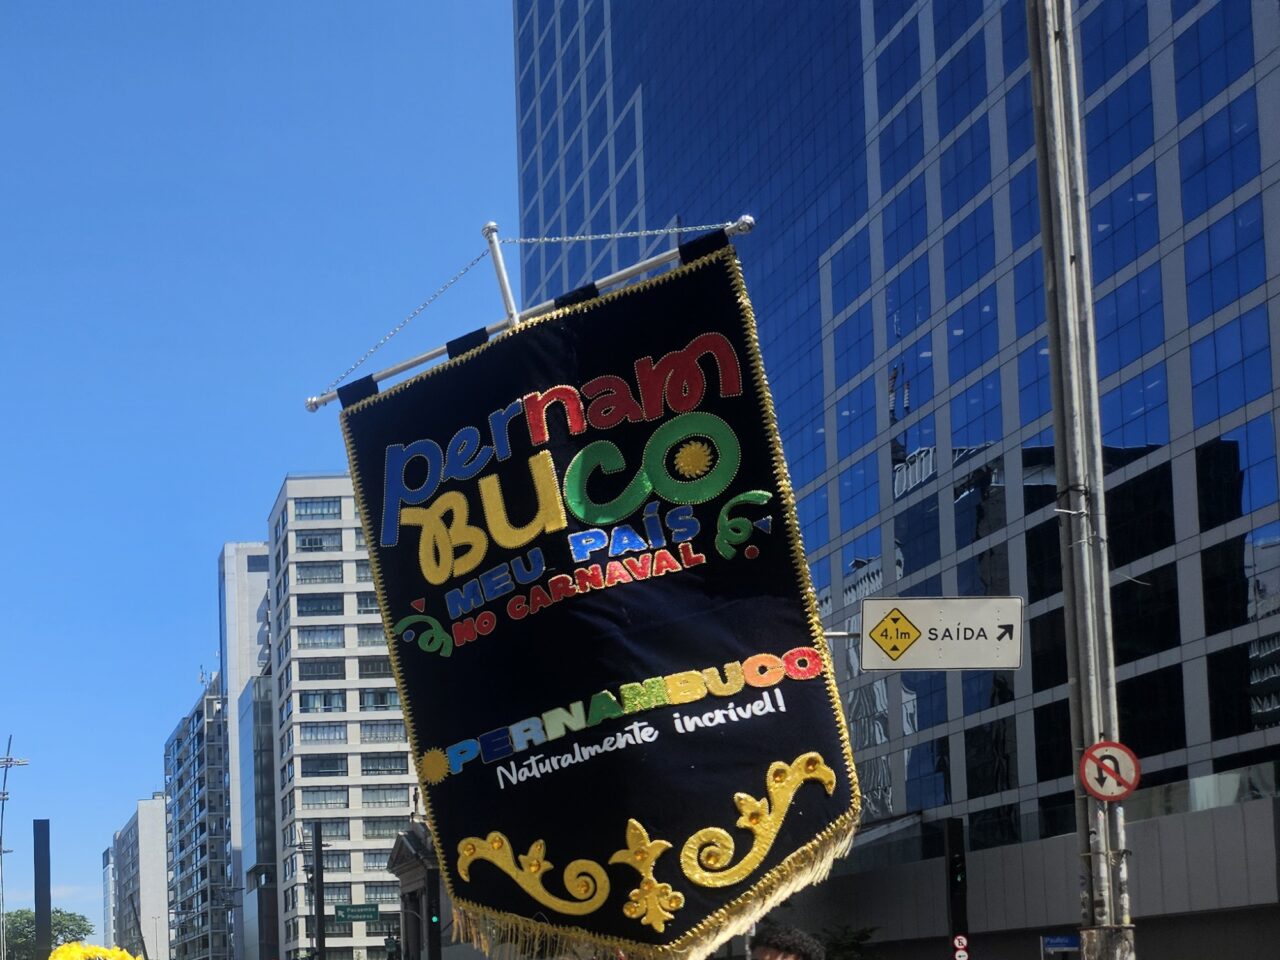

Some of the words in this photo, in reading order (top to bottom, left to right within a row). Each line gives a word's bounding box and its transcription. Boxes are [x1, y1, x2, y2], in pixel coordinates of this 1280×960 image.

[380, 331, 742, 547] pernam
[401, 411, 742, 585] BUCO
[445, 547, 545, 619] MEU
[568, 500, 701, 562] PAÍS
[452, 611, 496, 647] NO
[508, 543, 706, 620] CARNAVAL
[928, 622, 988, 641] SAÍDA
[447, 647, 821, 775] PERNAMBUCO
[496, 722, 659, 789] Naturalmente
